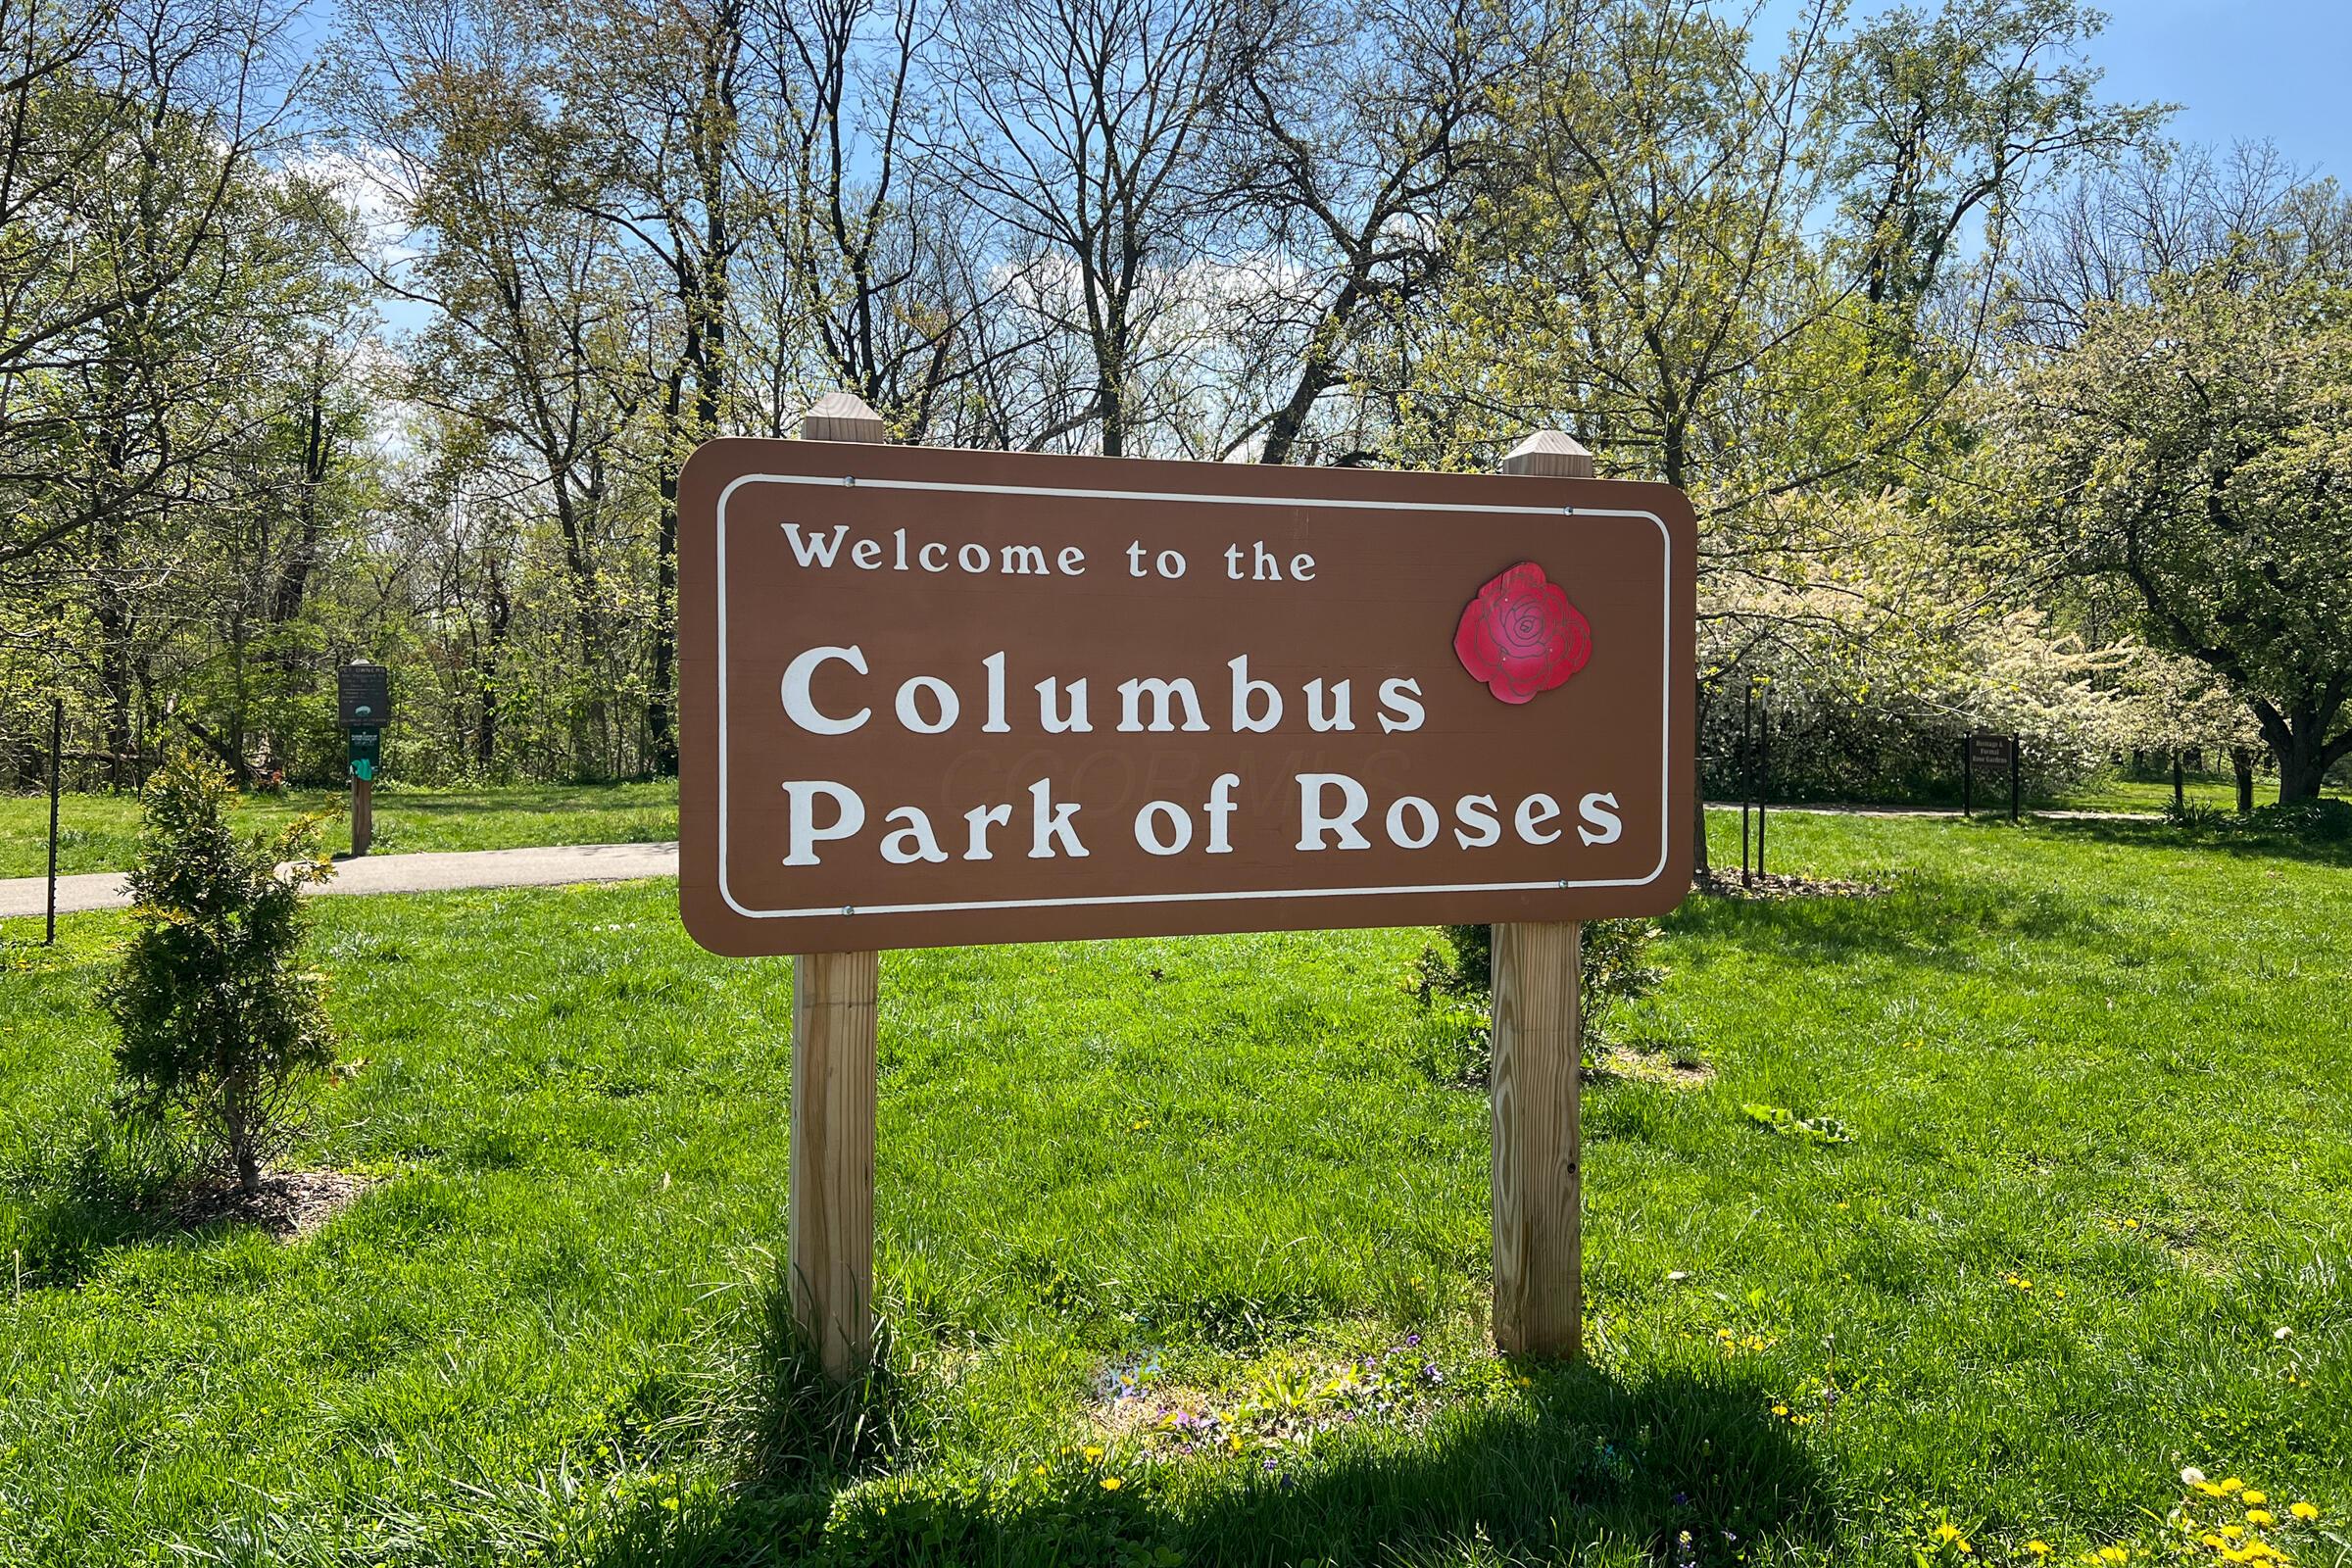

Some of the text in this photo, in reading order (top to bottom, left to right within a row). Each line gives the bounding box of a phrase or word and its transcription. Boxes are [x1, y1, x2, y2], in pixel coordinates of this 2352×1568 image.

[780, 522, 1316, 581] Welcome to the
[780, 644, 1426, 736] Columbus
[781, 772, 1623, 866] Park of Roses
